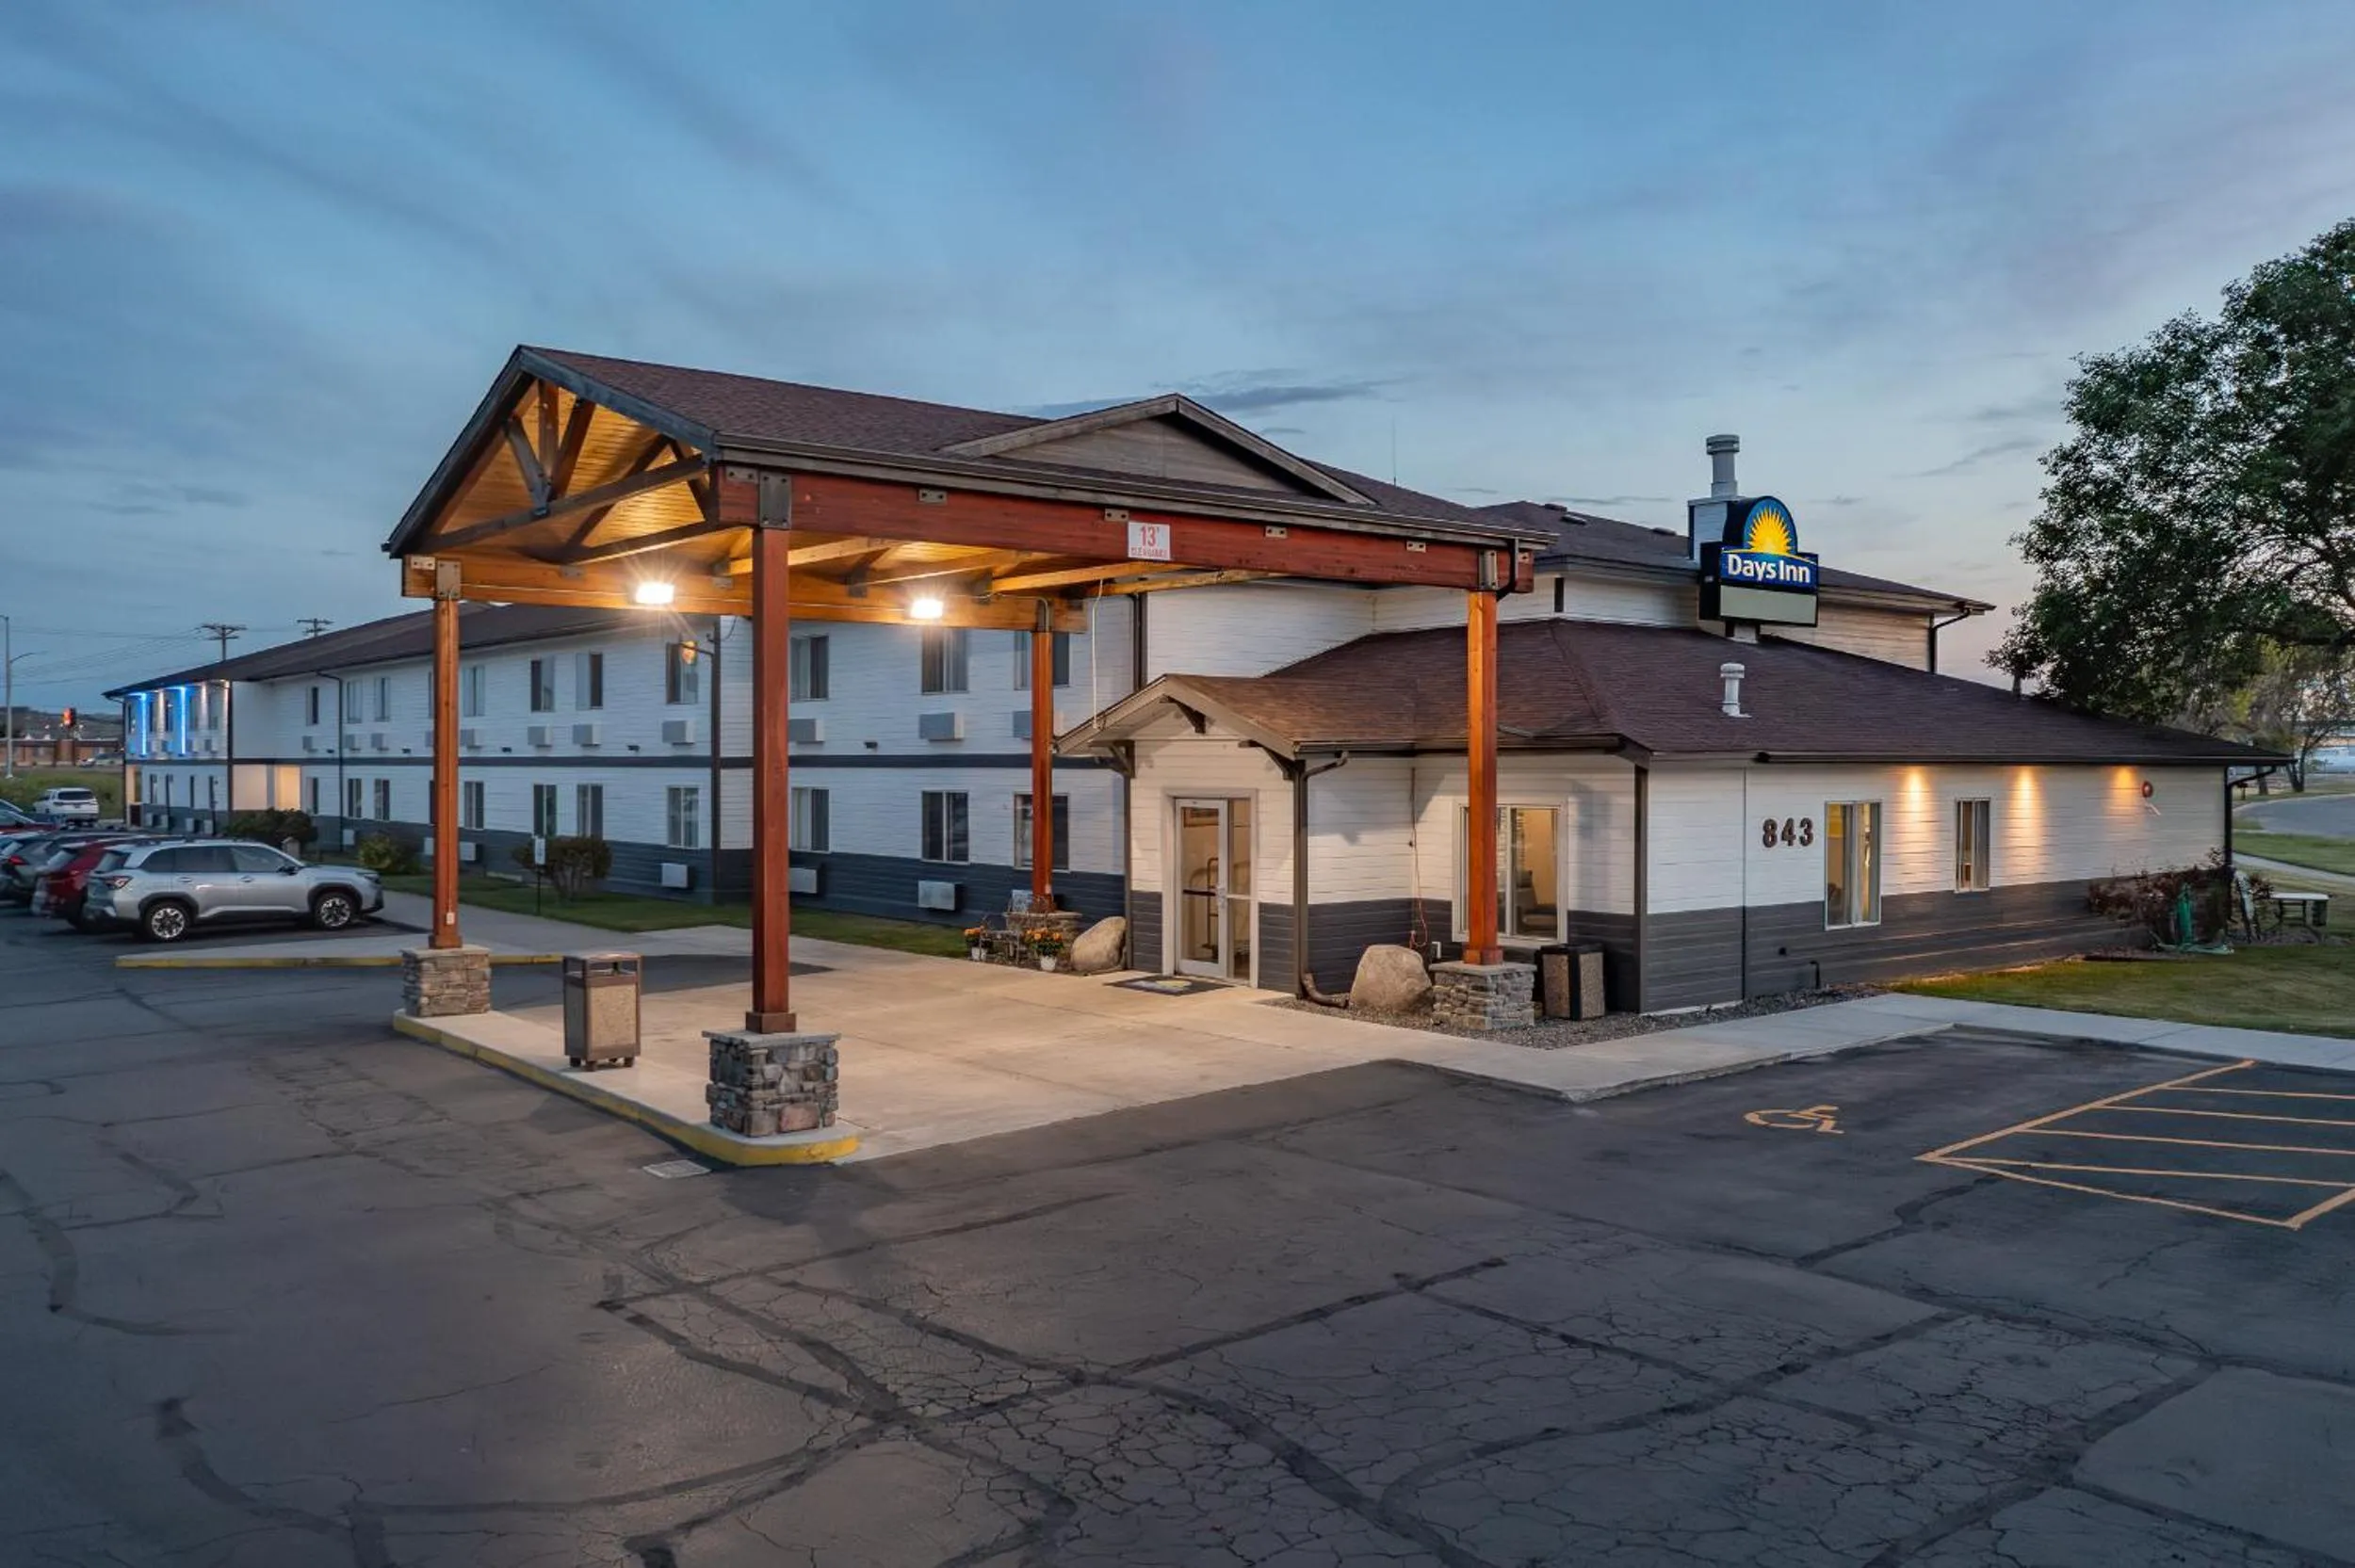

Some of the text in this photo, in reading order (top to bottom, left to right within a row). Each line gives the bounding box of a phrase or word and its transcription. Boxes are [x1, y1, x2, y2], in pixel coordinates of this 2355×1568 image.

[1728, 554, 1811, 583] Days Inn
[1762, 816, 1813, 849] 843
